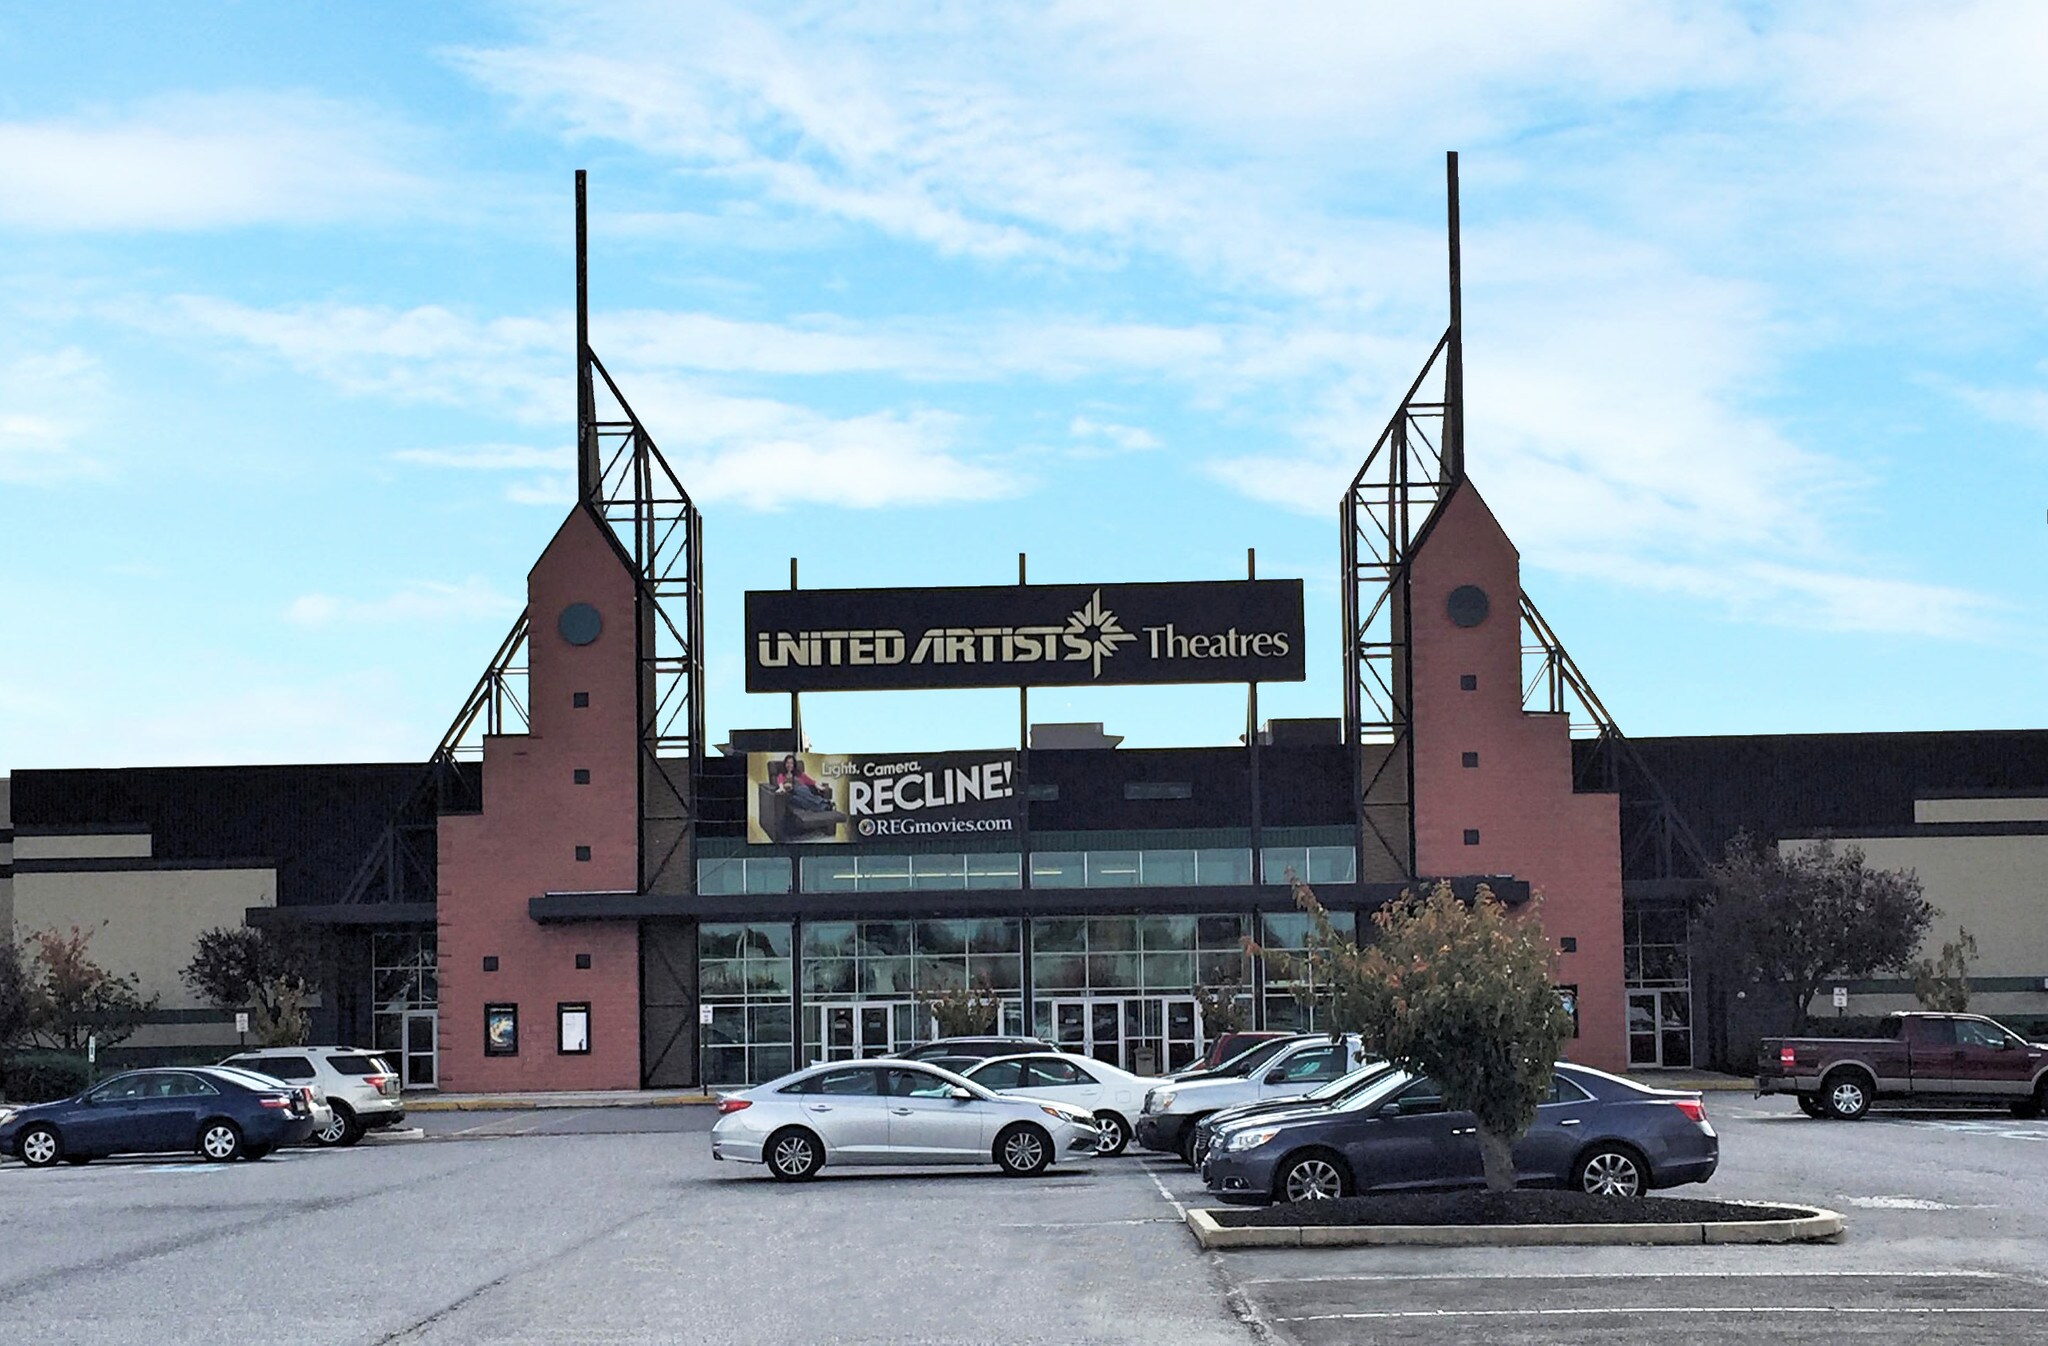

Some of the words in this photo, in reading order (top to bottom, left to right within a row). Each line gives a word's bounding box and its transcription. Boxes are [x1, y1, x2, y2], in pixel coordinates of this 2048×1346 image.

[758, 629, 905, 667] UNITED
[910, 626, 1093, 664] ARTISTS
[1142, 623, 1290, 659] Theatres
[849, 761, 1013, 816] RECLINE!
[877, 817, 1013, 835] REGmovies.com
